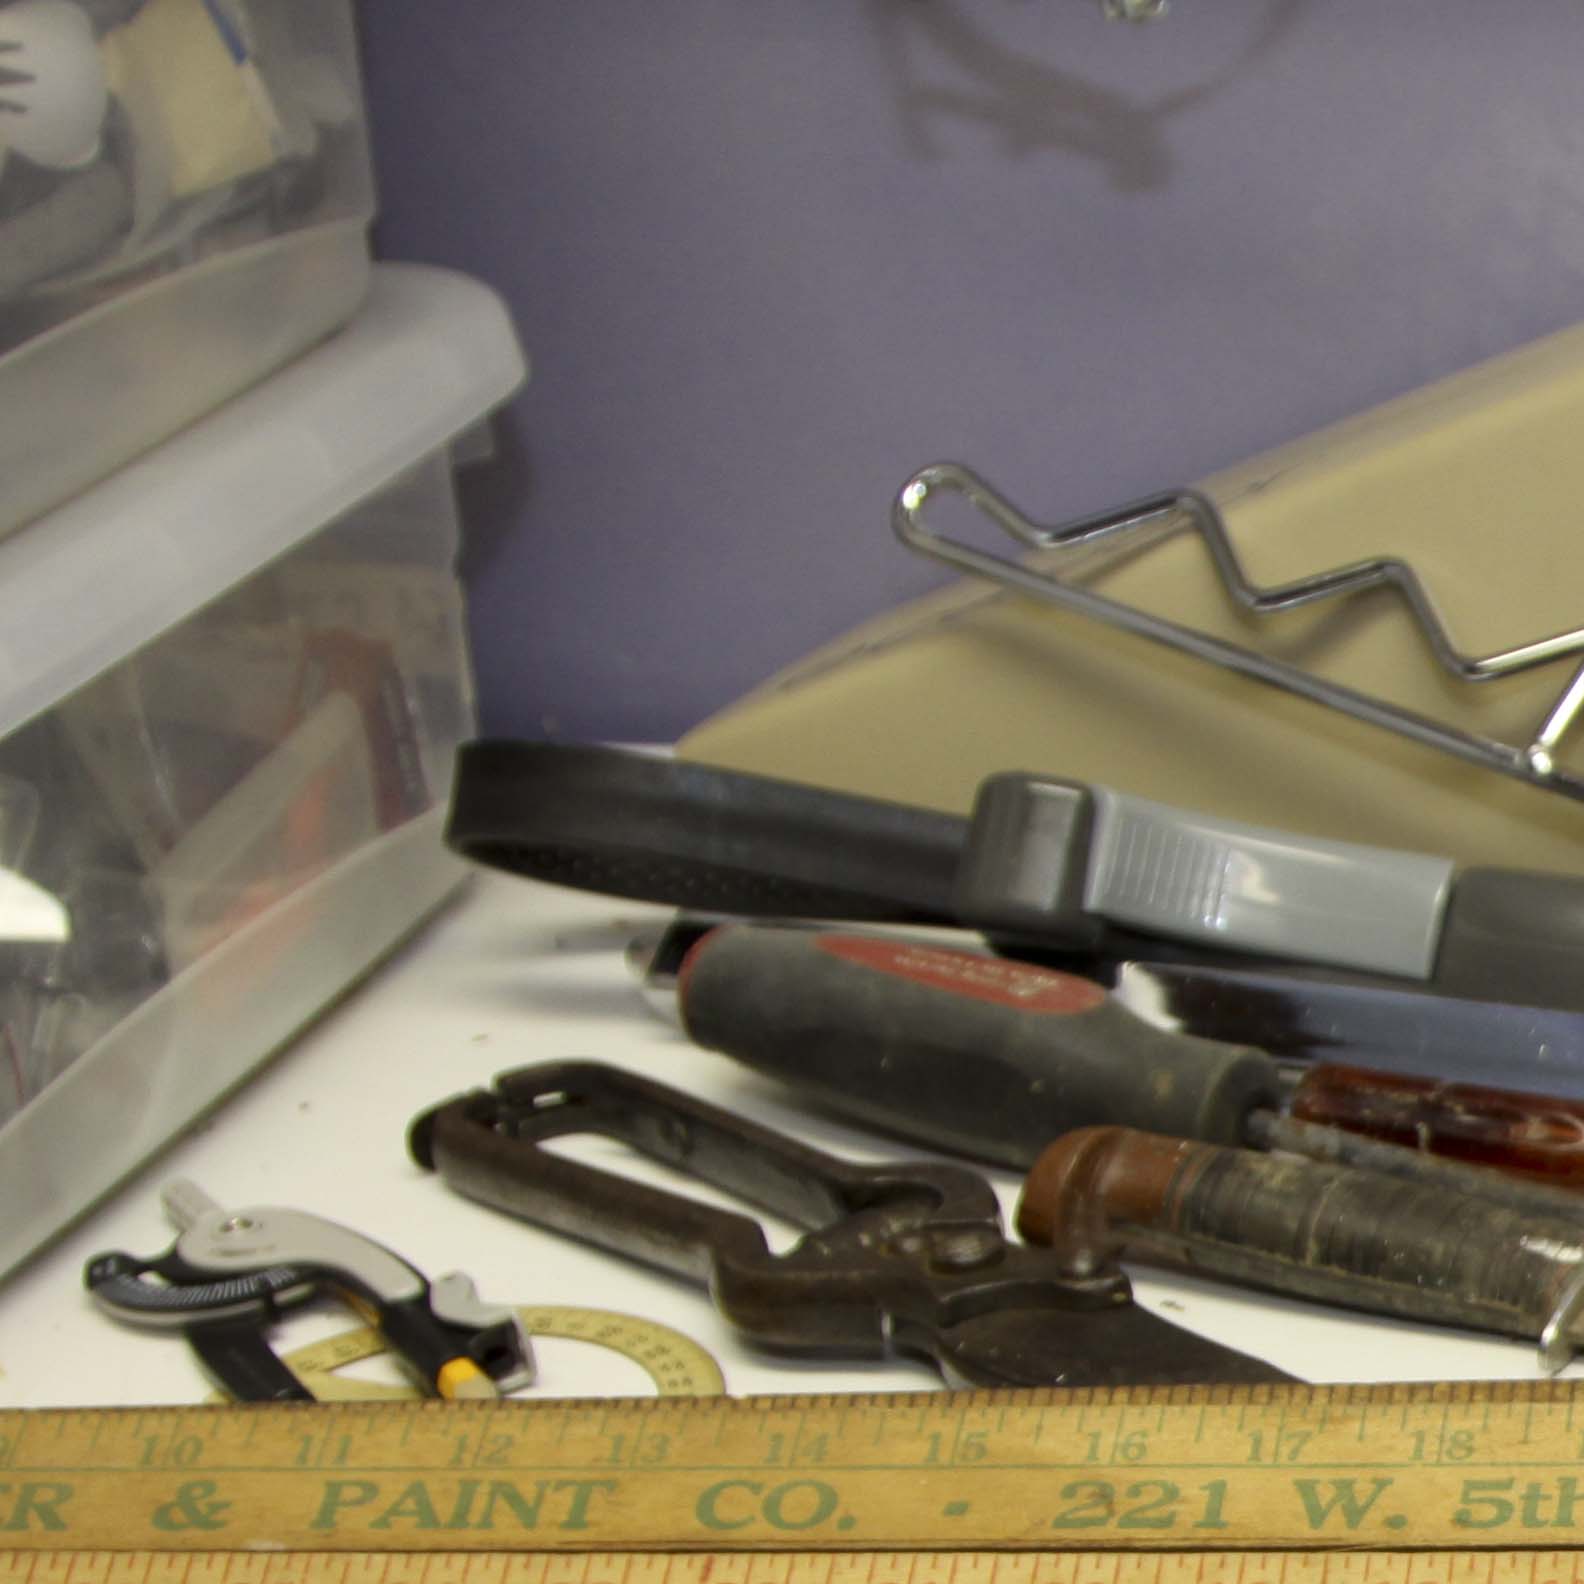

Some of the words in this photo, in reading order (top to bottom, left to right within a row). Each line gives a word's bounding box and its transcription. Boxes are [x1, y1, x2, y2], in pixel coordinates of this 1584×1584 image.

[139, 1434, 203, 1467] 10
[295, 1432, 351, 1466] 11
[450, 1434, 514, 1465] 12
[605, 1435, 669, 1465] 13
[766, 1432, 830, 1463] 14
[924, 1432, 988, 1461] 15
[1084, 1431, 1148, 1461] 16
[1245, 1430, 1312, 1460] 17
[1409, 1430, 1475, 1461] 18
[152, 1478, 232, 1531] &
[309, 1478, 620, 1530] PAINT
[695, 1479, 858, 1531] CO.
[1051, 1479, 1232, 1529] 221
[1293, 1477, 1407, 1529] W.
